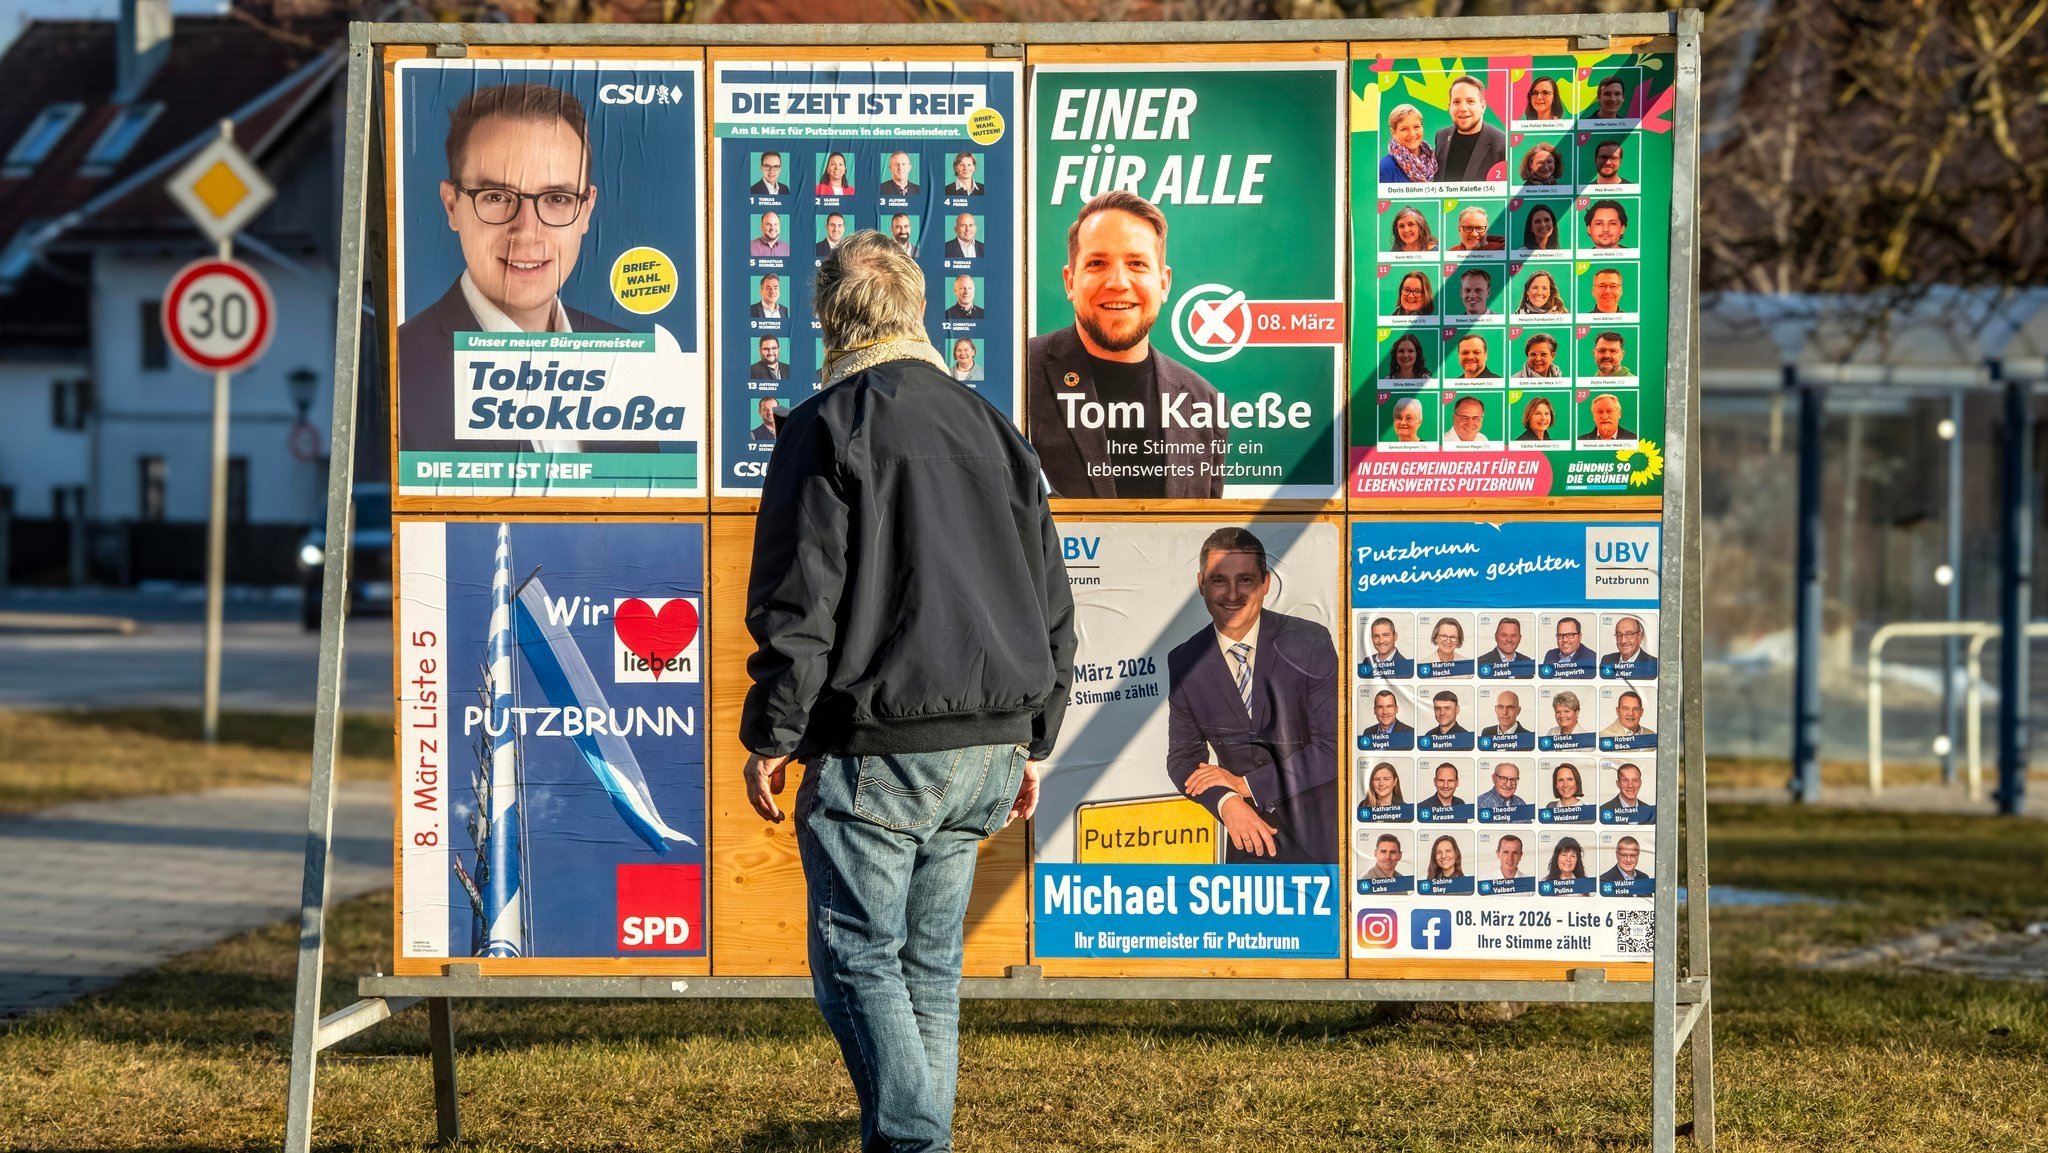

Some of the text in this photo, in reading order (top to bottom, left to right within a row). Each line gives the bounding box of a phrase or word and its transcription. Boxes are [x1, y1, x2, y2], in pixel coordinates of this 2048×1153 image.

[599, 84, 656, 105] CSU
[732, 92, 974, 114] DIE ZEIT IST REIF
[1050, 88, 1198, 140] EINER
[731, 126, 960, 136] Am 8. März für Putzbrunn in den Gemeinderat.
[1050, 144, 1272, 205] FÜR ALLE
[1496, 170, 1502, 179] 2
[622, 260, 661, 273] BRIEF-
[627, 273, 661, 285] WAHL
[621, 284, 671, 298] NUTZEN!
[189, 292, 247, 340] 30
[1258, 314, 1336, 330] 08. März
[468, 336, 645, 350] Unser neuer Bürgermeister
[469, 360, 606, 392] Tobias
[468, 396, 686, 430] Stokloßa
[1057, 392, 1312, 429] Tom Kaleße
[1106, 440, 1264, 454] Ihre Stimme für ein
[416, 462, 592, 479] DIE ZEIT IST REIF
[1087, 462, 1283, 477] lebenswertes Putzbrunn
[1358, 460, 1540, 475] IN DEN GEMEINDERAT FÜR EIN
[1568, 462, 1631, 472] BÜNDNIS 90
[1358, 478, 1536, 492] LEBENSWERTES PUTZBRUNN
[1566, 472, 1629, 484] DIE GRÜNEN
[1063, 536, 1100, 560] BV
[1358, 540, 1480, 564] Putzbrunn
[1595, 541, 1650, 564] UBV
[1358, 554, 1580, 592] gemeinsam gestalten
[1596, 575, 1649, 586] Putzbrunn
[544, 596, 609, 626] Wir
[624, 652, 692, 672] lieben
[1074, 656, 1156, 683] März 2026
[1554, 668, 1585, 676] Jungwirth
[1076, 690, 1121, 705] Stimme
[1125, 682, 1159, 700] zählt!
[464, 705, 694, 737] PUTZBRUNN
[412, 630, 438, 847] 8. März Liste 5
[1085, 826, 1209, 850] Putzbrunn
[1044, 874, 1331, 916] Michael SCHULTZ
[1456, 910, 1476, 926] 08.
[1480, 910, 1514, 927] März
[1520, 910, 1552, 927] 2026
[1568, 910, 1600, 928] Liste
[1605, 912, 1614, 928] 6
[622, 916, 690, 946] SPD
[1074, 932, 1300, 954] Ihr Bürgermeister für Putzbrunn
[1478, 934, 1591, 950] Ihre Stimme zählt!
